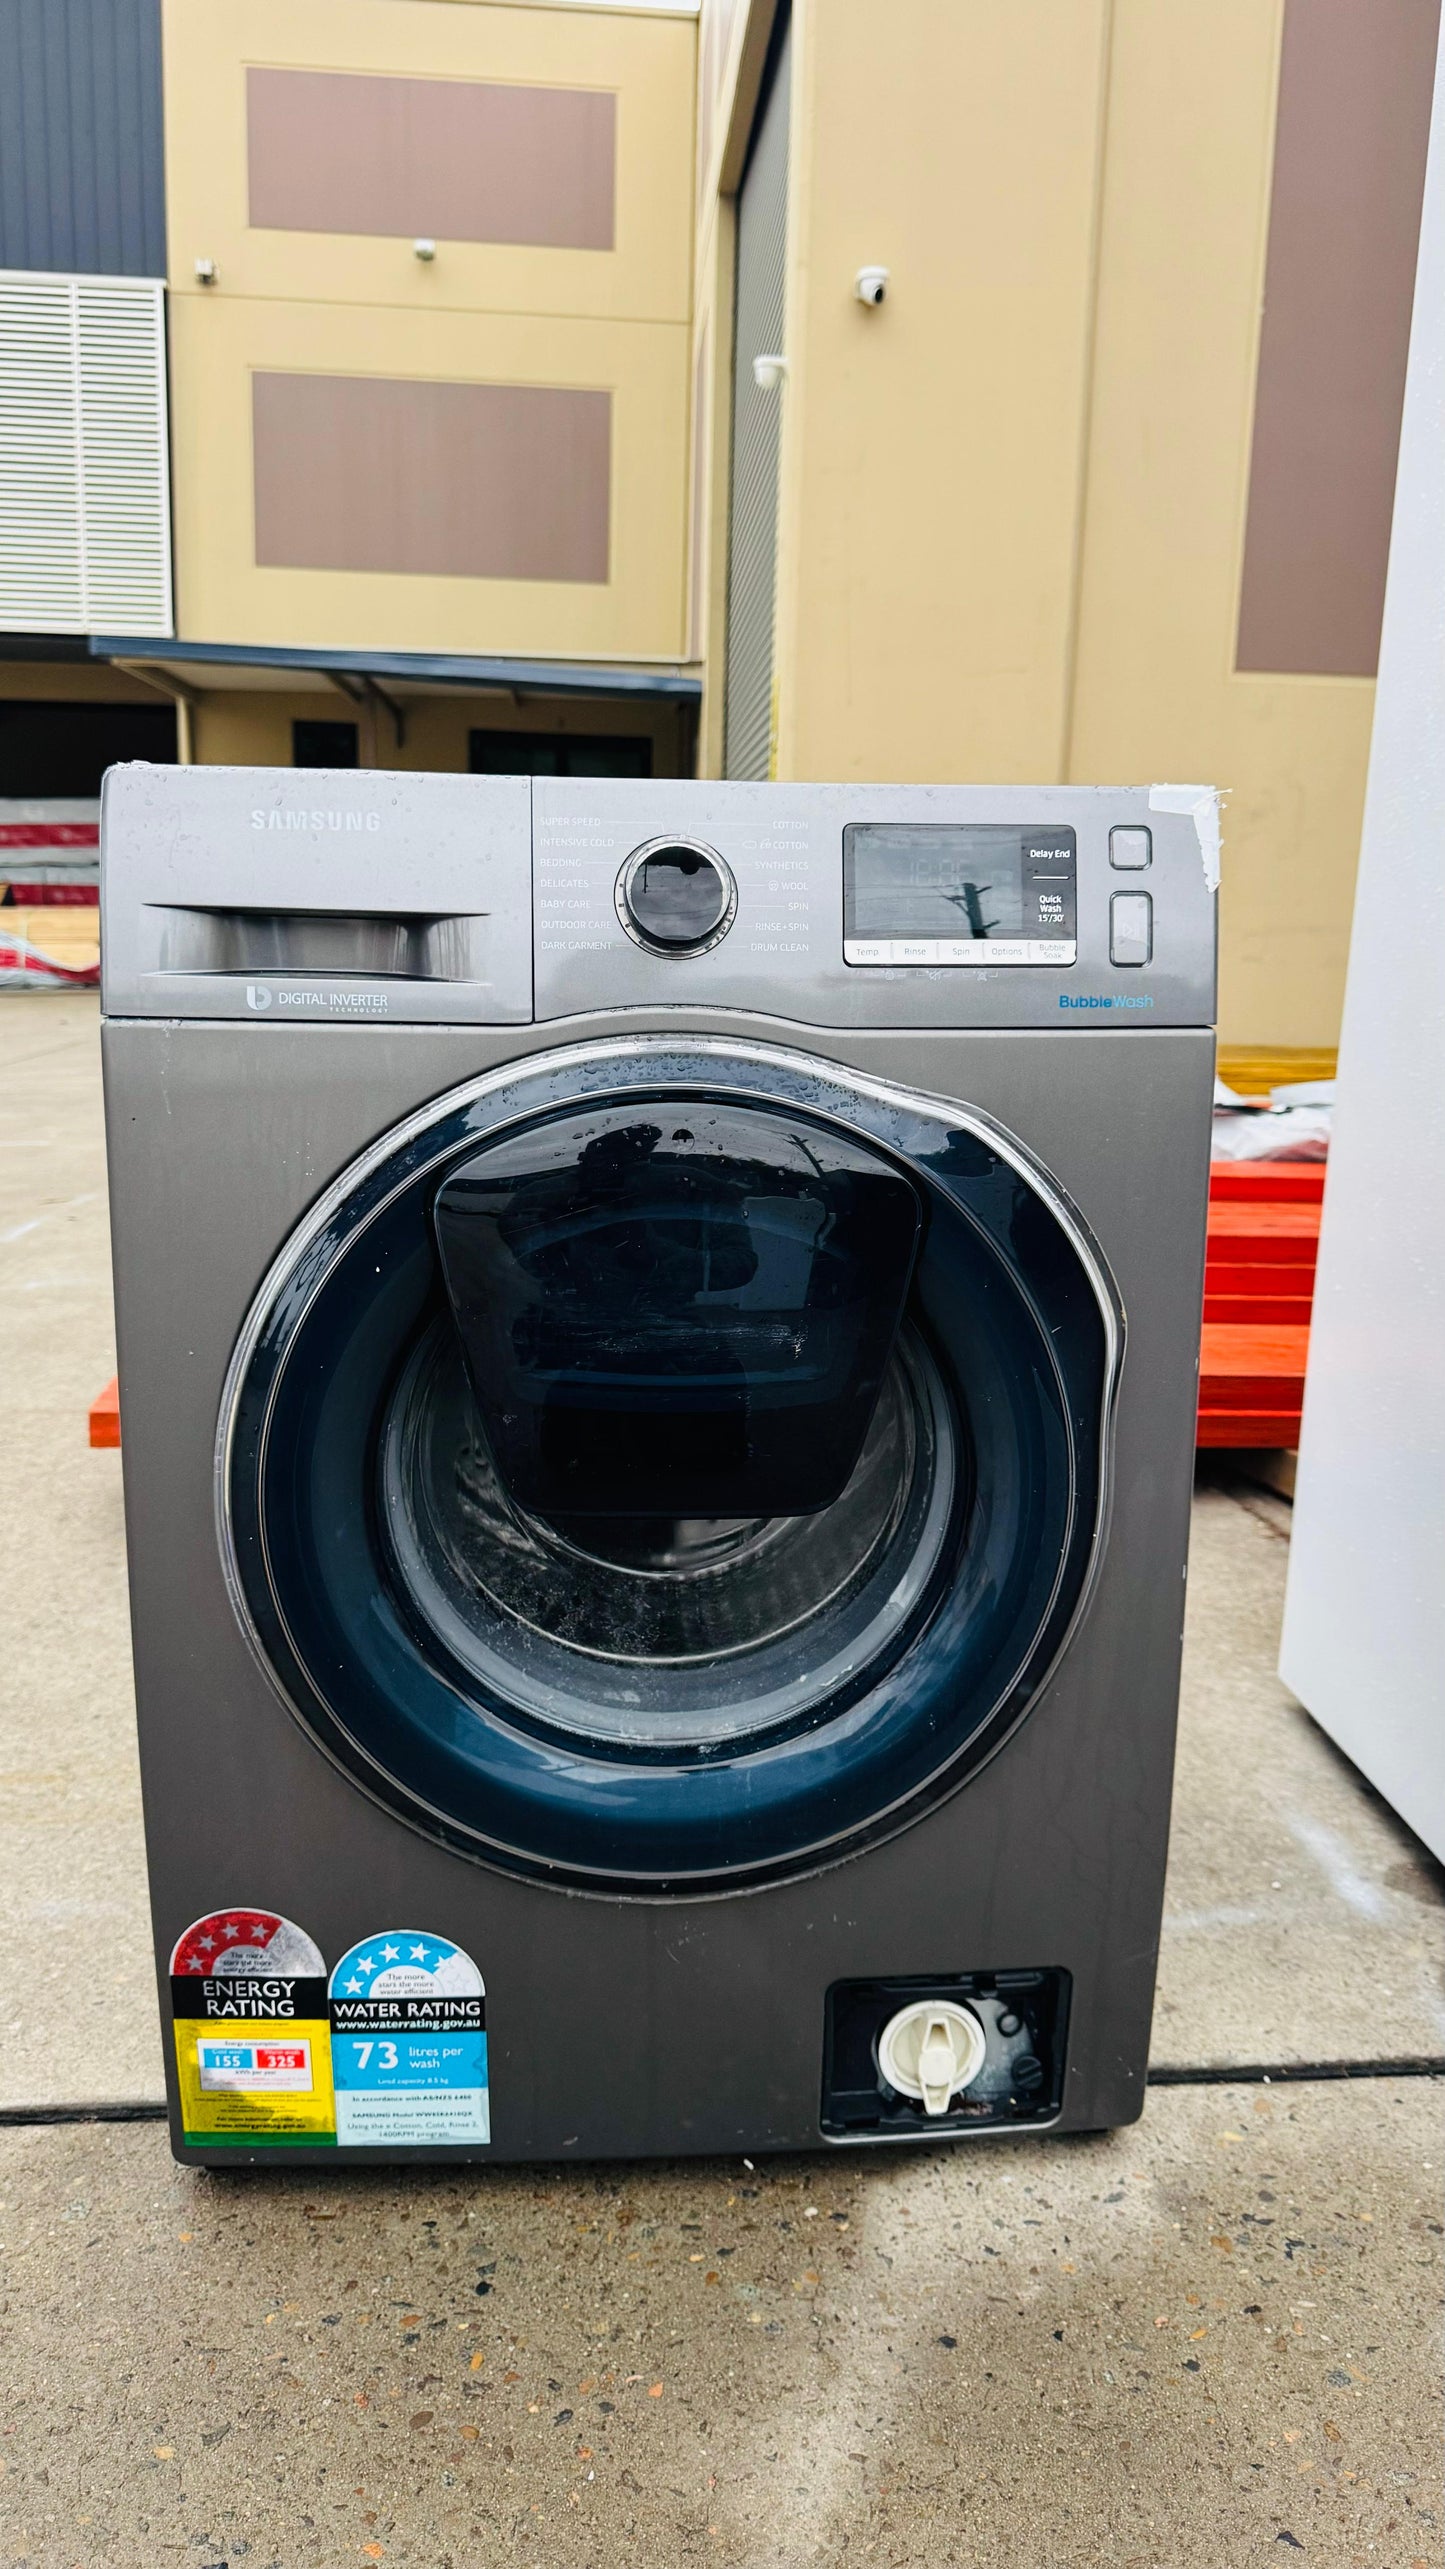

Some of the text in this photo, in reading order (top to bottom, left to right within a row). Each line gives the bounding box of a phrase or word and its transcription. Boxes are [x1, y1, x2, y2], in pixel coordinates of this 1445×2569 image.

[251, 810, 380, 831] SAMSUNG
[540, 817, 601, 826] SUPER SPEED
[773, 821, 808, 829] COTTON
[540, 838, 614, 847] INTENSIVE COLD
[773, 841, 808, 849] COTTON
[1030, 850, 1070, 859] Delay End
[540, 858, 582, 867] BEDDING
[754, 861, 808, 870] SYNTHETICS
[540, 879, 589, 888] DELICATES
[781, 882, 808, 890] WOOL
[1039, 895, 1062, 904] Quick
[540, 900, 591, 909] BABY CARE
[788, 902, 809, 911] SPIN
[1040, 904, 1062, 913] Wash
[541, 921, 612, 929] OUTDOOR CARE
[541, 941, 612, 950] DARK GARMENT
[751, 943, 809, 952] DRUM CLEAN
[857, 948, 879, 957] Temp
[904, 947, 926, 956] Rinse
[952, 947, 970, 957] Spin
[991, 947, 1023, 957] Options
[1043, 951, 1062, 959] Soak
[279, 992, 388, 1006] DIGITAL INVERTER
[1059, 994, 1154, 1008] BubbleWash
[203, 1981, 296, 1997] ENERGY
[206, 2000, 295, 2017] RATING
[334, 2001, 481, 2018] WATER RATING
[336, 2018, 481, 2030] www.waterrating.gov.au
[352, 2041, 399, 2070] 73
[408, 2046, 464, 2059] litres per
[215, 2055, 241, 2067] 155
[268, 2055, 296, 2068] 325
[409, 2058, 440, 2069] wash
[396, 2078, 425, 2086] capacity
